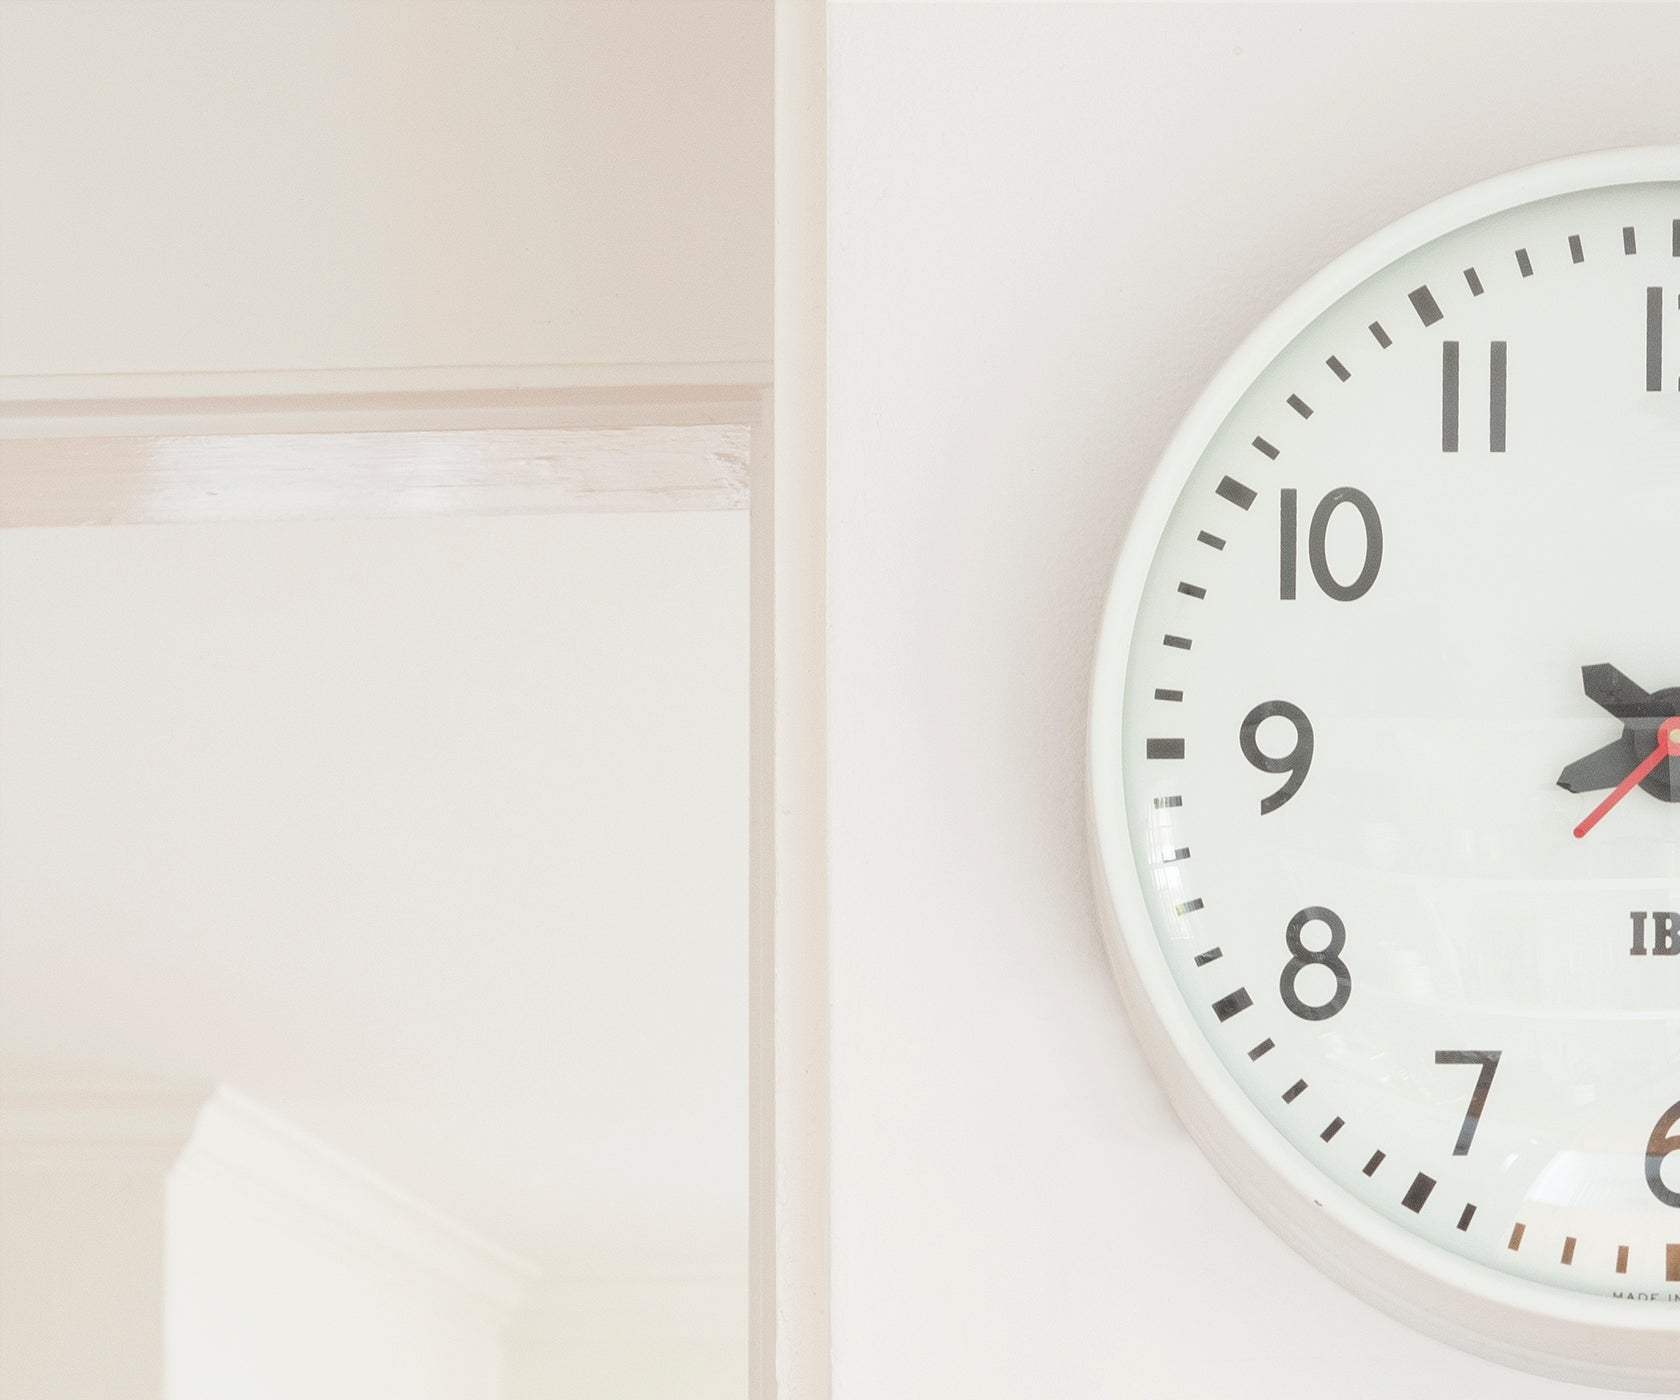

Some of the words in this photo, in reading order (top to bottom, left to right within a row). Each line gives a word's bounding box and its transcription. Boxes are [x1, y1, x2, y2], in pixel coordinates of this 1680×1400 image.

[1441, 340, 1508, 453] 11
[1279, 486, 1384, 602] 10
[1239, 699, 1315, 816] 9
[1279, 906, 1352, 1022] 8
[1434, 1050, 1502, 1156] 7
[1612, 1291, 1659, 1301] MADE
